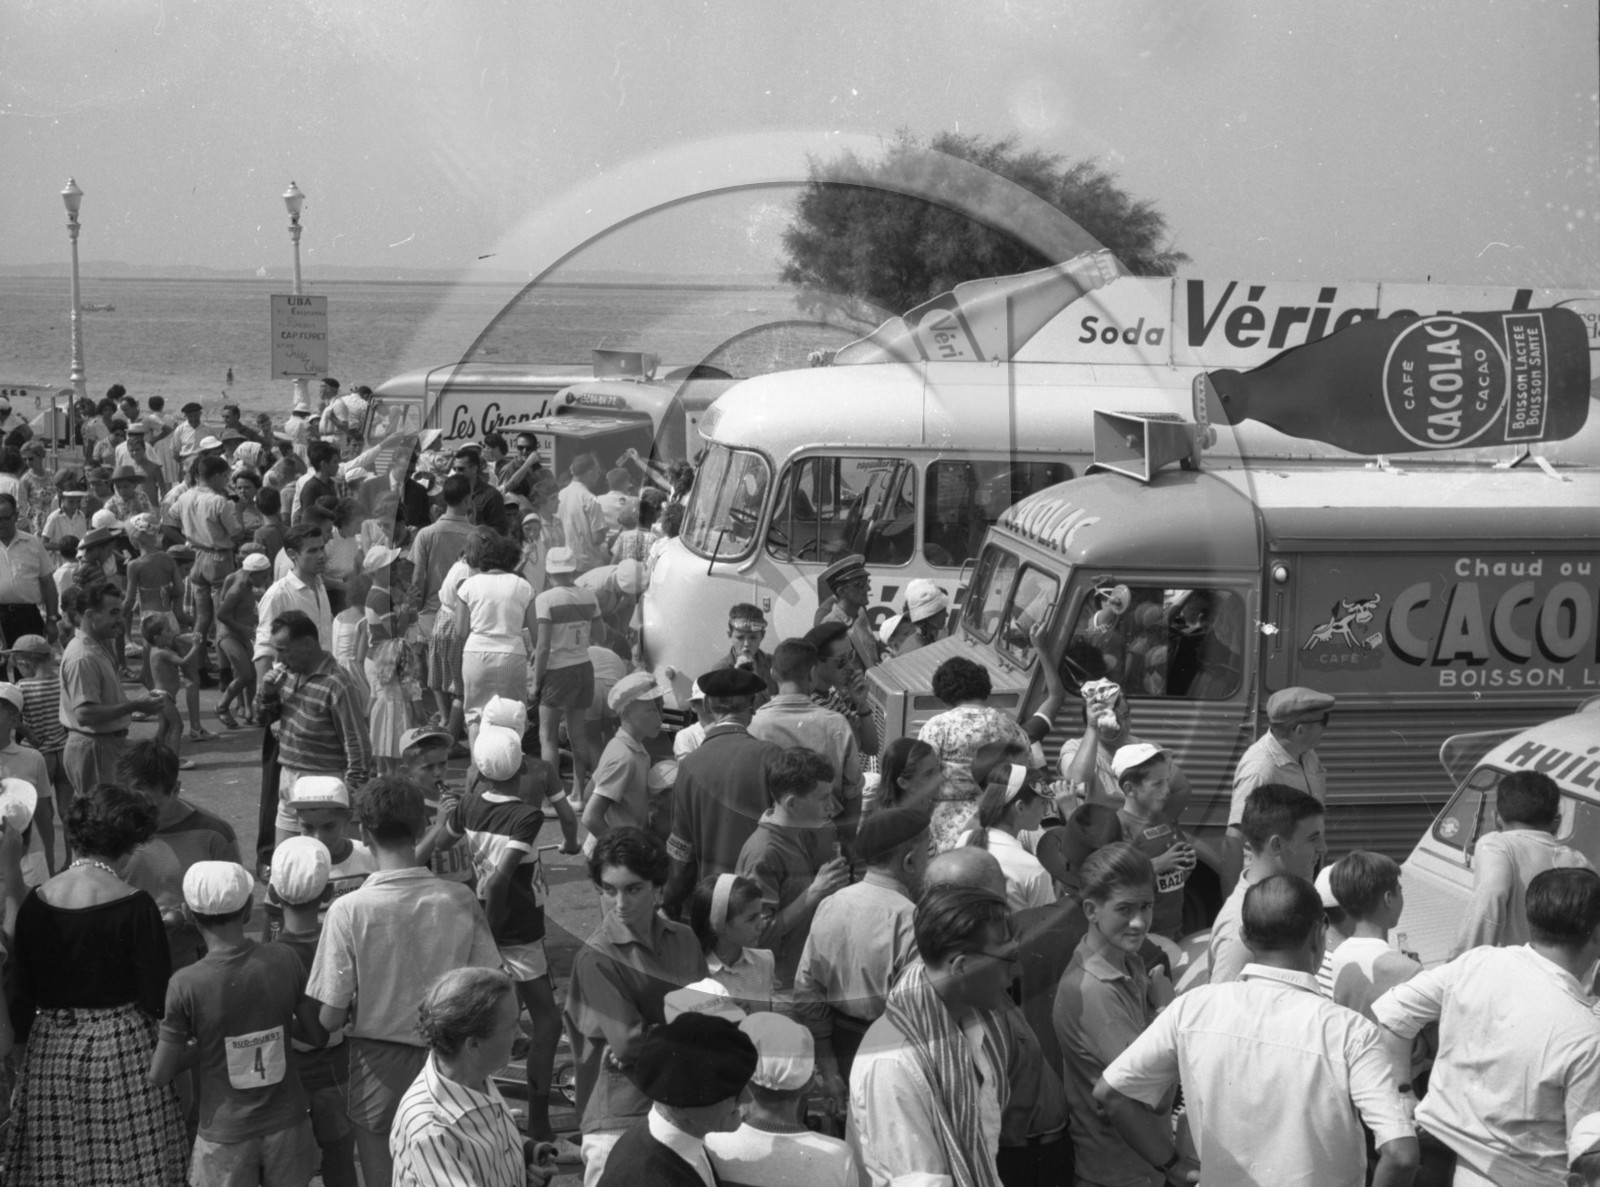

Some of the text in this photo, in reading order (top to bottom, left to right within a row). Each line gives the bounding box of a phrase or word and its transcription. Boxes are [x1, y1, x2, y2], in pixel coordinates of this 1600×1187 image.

[1078, 316, 1165, 346] Soda
[1403, 360, 1415, 409] CAFÉ
[1427, 324, 1463, 441] CACOLAC
[1474, 349, 1490, 411] CACAO
[1512, 374, 1527, 430] BOISSON
[1526, 370, 1542, 426] BOISSON
[443, 400, 553, 440] Les Grand
[1455, 558, 1591, 577] Chaud ou
[1384, 581, 1600, 667] CACO
[1439, 668, 1600, 687] BOISSON L
[232, 1032, 281, 1049] SUD-OUEST
[254, 1047, 266, 1080] 4
